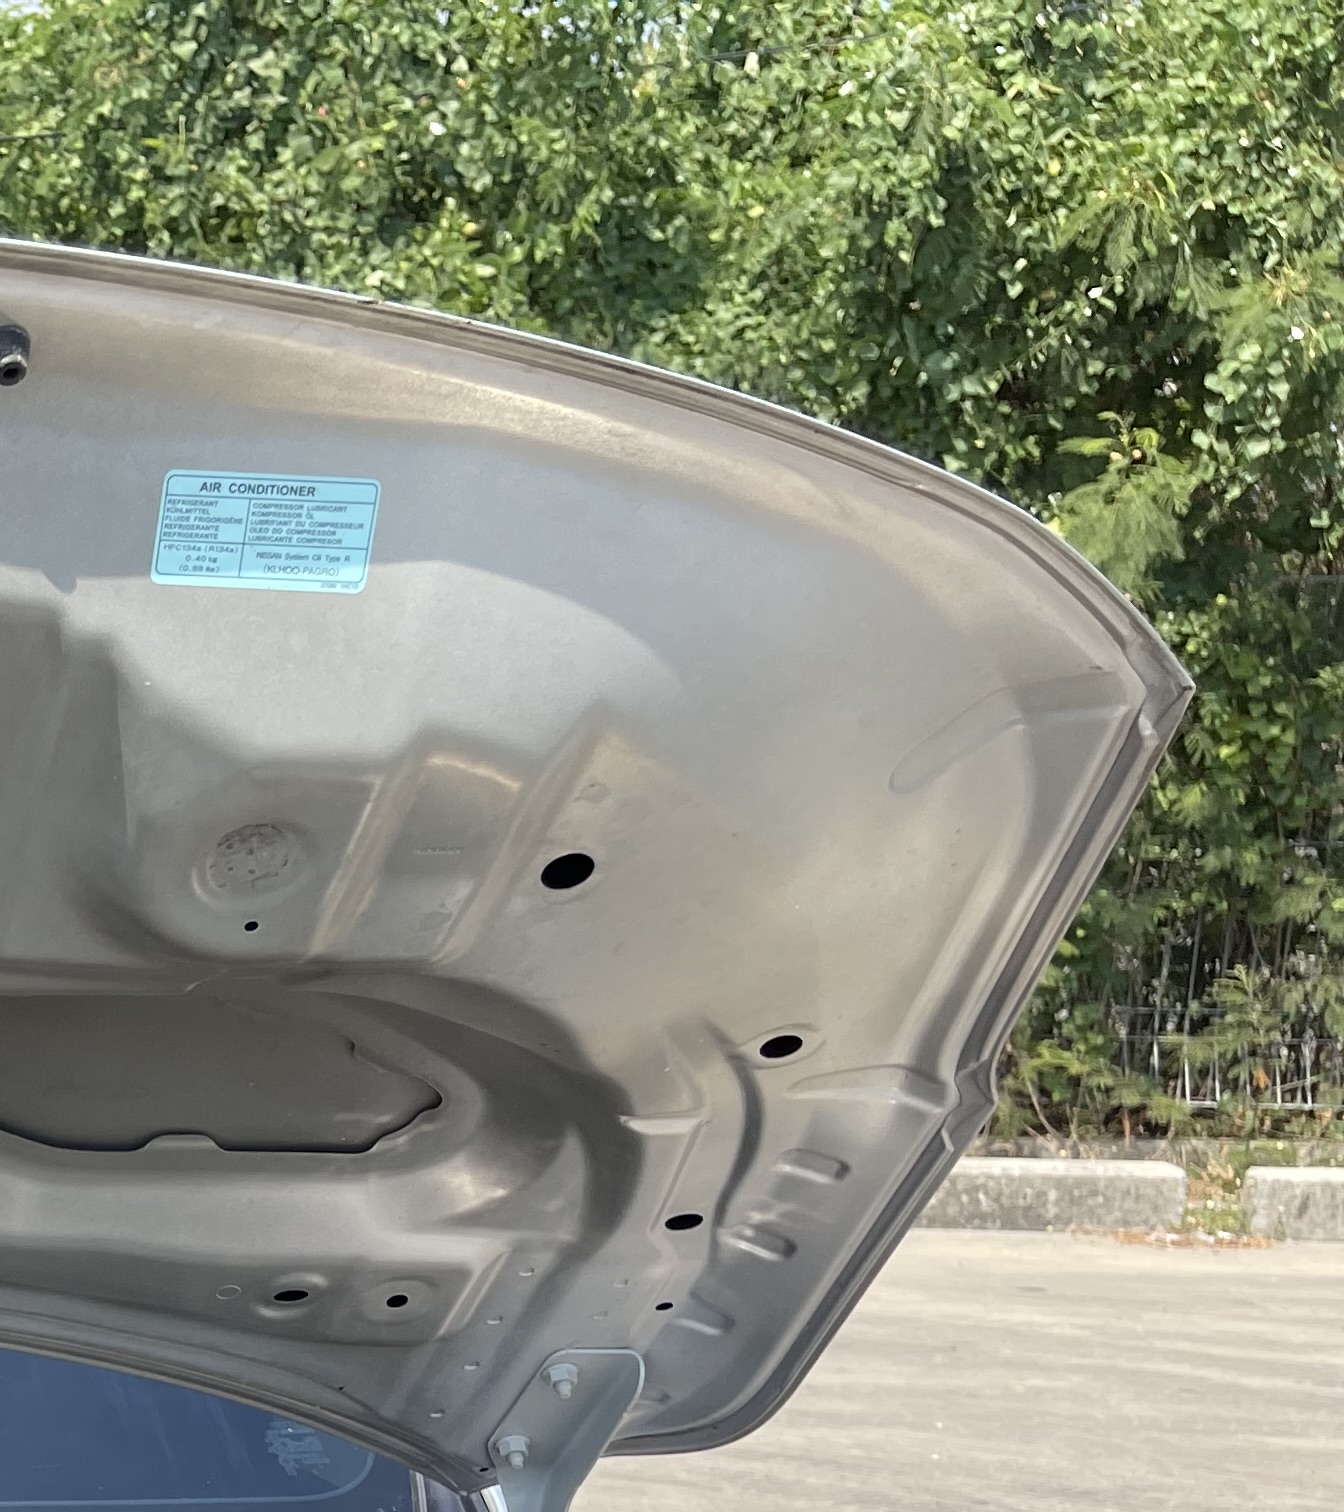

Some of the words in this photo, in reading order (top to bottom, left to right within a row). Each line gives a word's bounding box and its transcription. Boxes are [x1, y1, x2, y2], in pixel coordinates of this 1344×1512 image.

[199, 481, 222, 493] AIR
[228, 482, 316, 497] CONDITIONER
[167, 498, 219, 508] REFRIGERANT
[252, 502, 305, 511] COMPRESSOR
[307, 504, 348, 513] LUBRICANT
